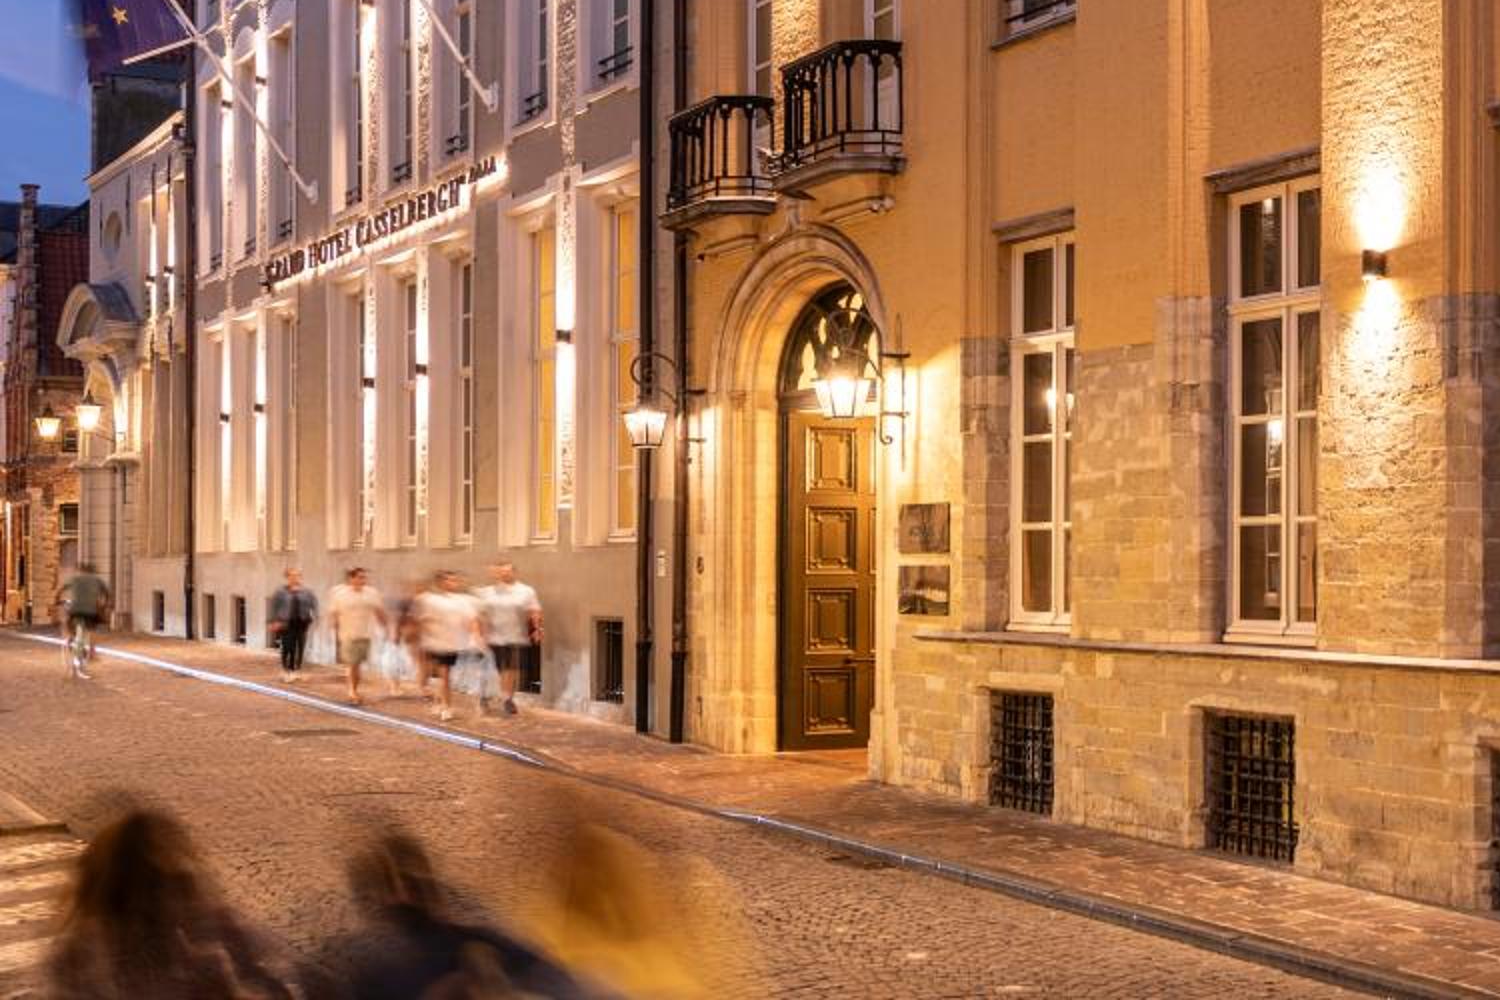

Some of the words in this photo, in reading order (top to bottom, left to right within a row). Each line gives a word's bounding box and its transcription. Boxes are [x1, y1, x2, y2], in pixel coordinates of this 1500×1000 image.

[266, 249, 305, 281] GRAND
[308, 229, 352, 268] HOTEL
[355, 180, 460, 247] CASSELBERGH
